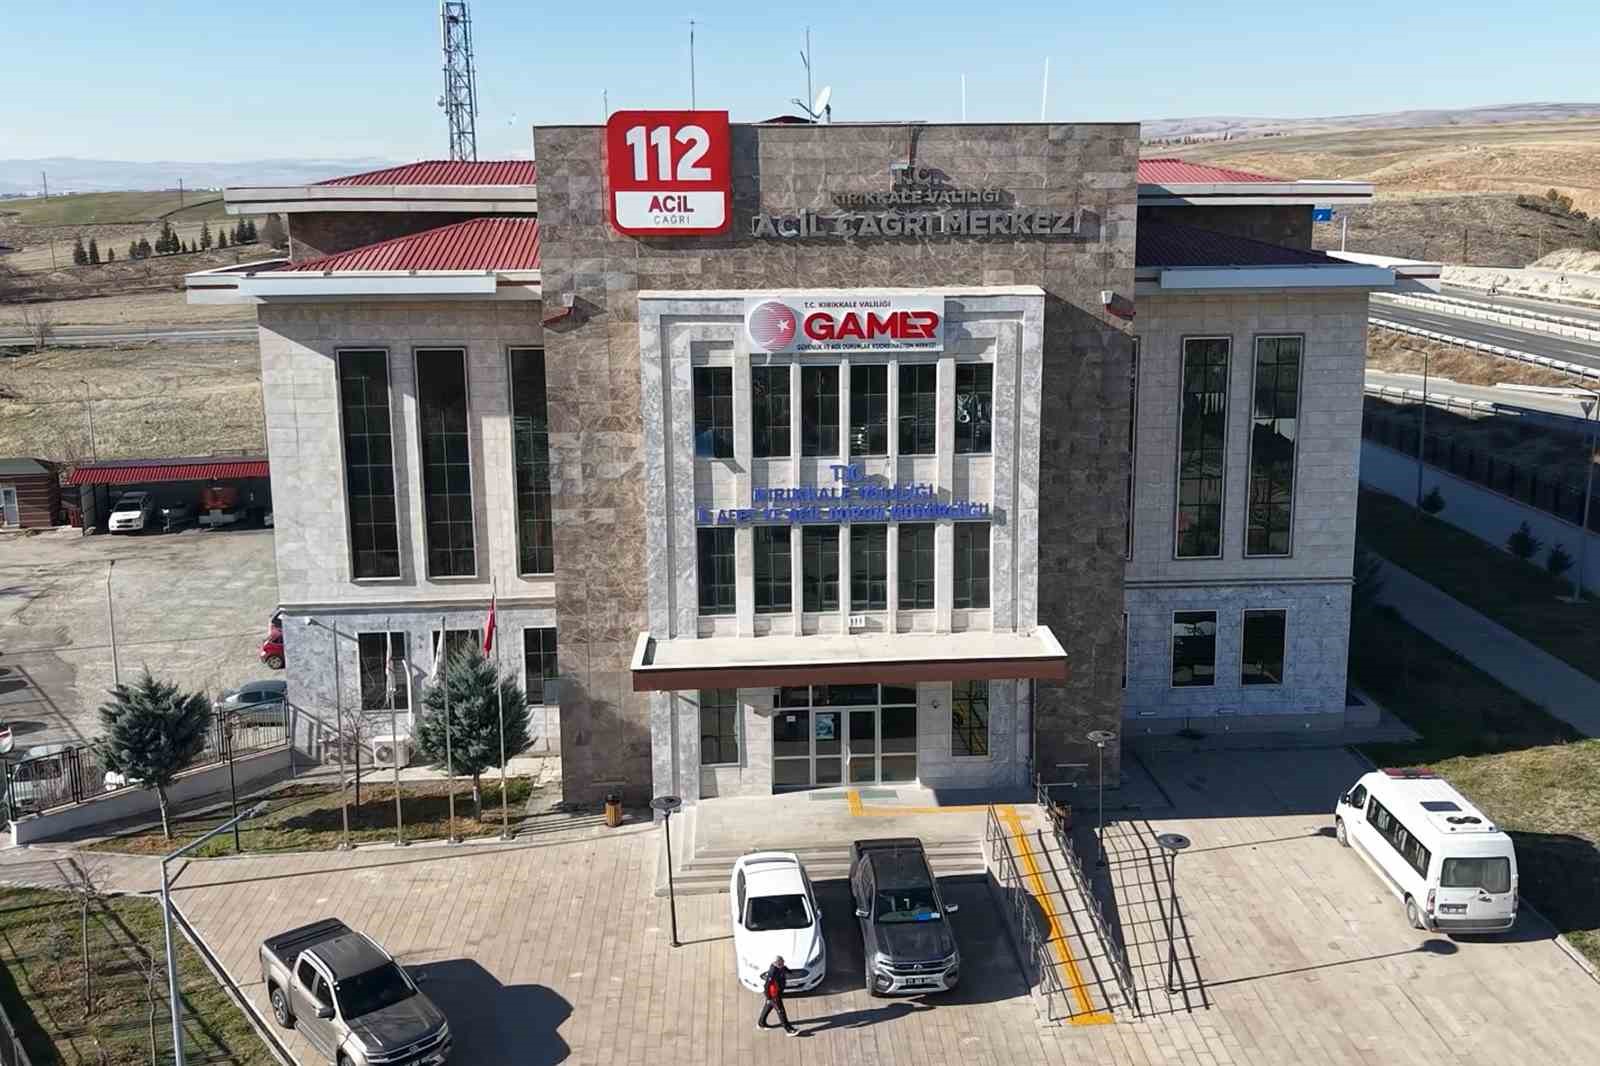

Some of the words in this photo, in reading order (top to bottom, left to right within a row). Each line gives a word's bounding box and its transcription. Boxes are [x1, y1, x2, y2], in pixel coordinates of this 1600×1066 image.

[626, 125, 712, 181] 112
[648, 195, 694, 213] ACİL
[654, 214, 690, 225] ÇAĞRI
[751, 208, 827, 238] ACİL
[834, 207, 933, 242] ÇAĞRI
[803, 311, 940, 341] GAMER
[753, 486, 852, 502] IRIKALE
